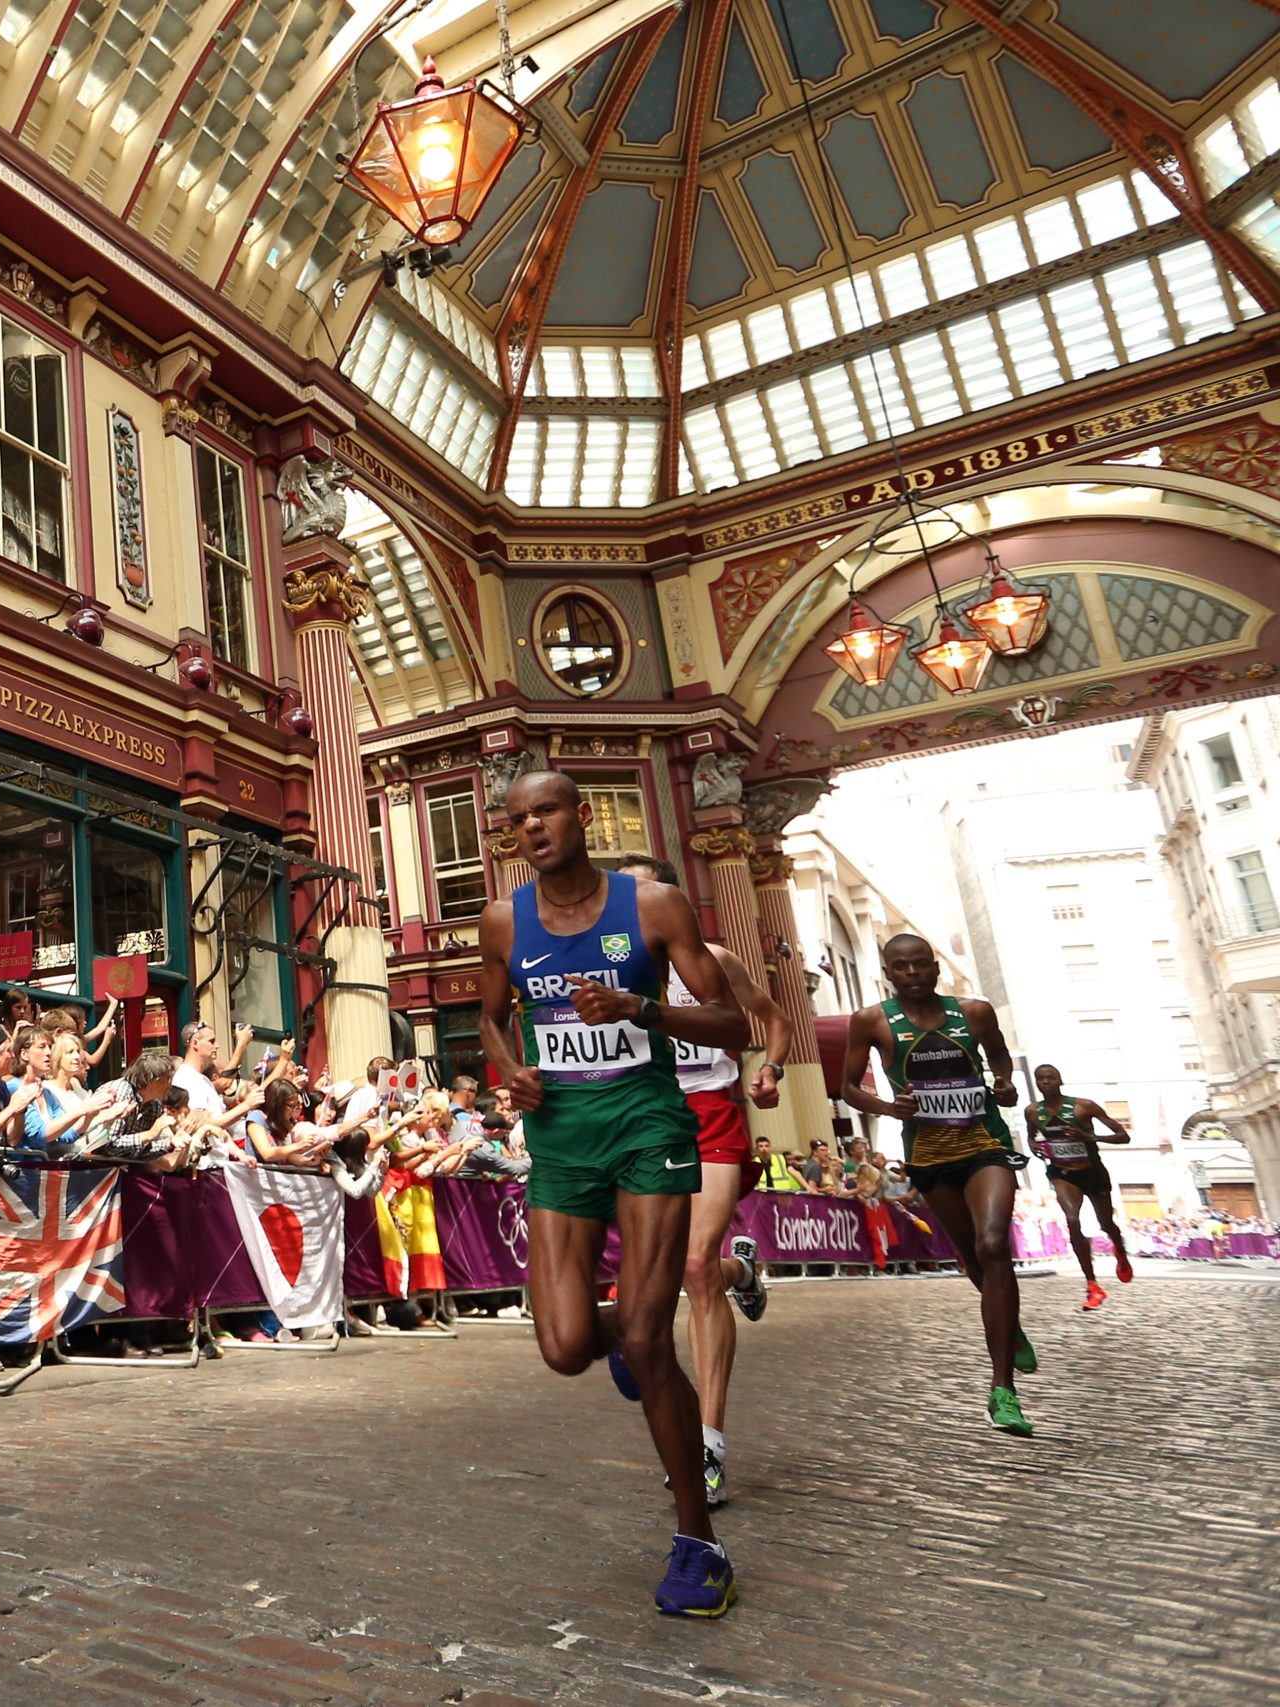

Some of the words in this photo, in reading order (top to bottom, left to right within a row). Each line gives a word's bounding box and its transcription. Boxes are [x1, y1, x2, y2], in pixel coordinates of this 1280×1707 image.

[868, 469, 936, 504] AD
[959, 433, 1055, 477] 1881
[0, 686, 167, 766] PIZZAEXPRESS
[239, 780, 256, 802] 22
[450, 982, 460, 994] 8
[465, 980, 477, 992] &
[554, 1009, 581, 1022] Londo
[546, 1028, 636, 1064] PAULA
[911, 1049, 964, 1062] Zimbabwe
[951, 1080, 967, 1088] 2012
[915, 1091, 984, 1114] UWAWO
[773, 1204, 827, 1251] London
[827, 1207, 861, 1252] 2012
